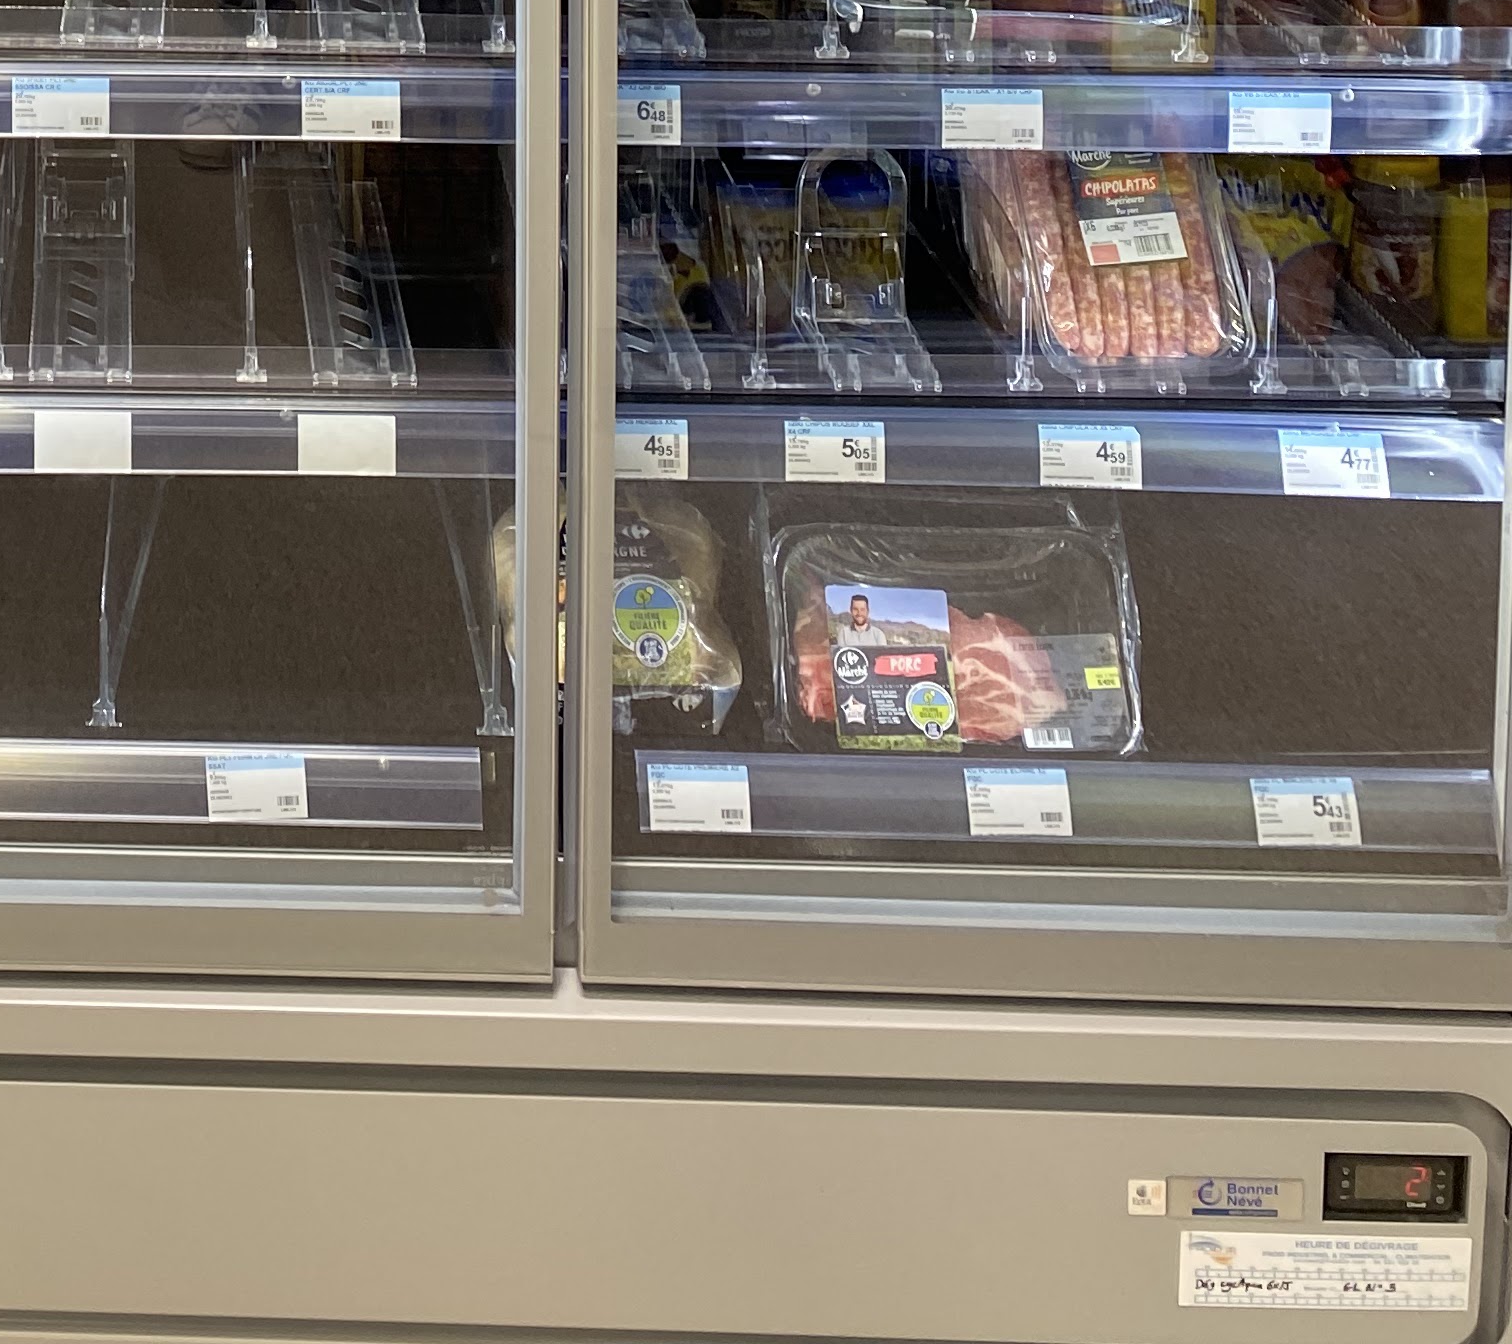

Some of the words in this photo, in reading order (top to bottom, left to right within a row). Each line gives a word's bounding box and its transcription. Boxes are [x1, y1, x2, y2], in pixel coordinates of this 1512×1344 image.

[1083, 175, 1157, 197] CHIPOLATAS
[628, 618, 668, 631] QUALITÉ
[889, 657, 922, 672] PORC
[836, 667, 868, 680] Marché
[1405, 1164, 1428, 1198] 2
[1226, 1182, 1279, 1196] Bonnet
[1226, 1195, 1263, 1207] Névé
[1295, 1240, 1333, 1251] HEURE
[1335, 1241, 1350, 1251] DE
[1353, 1239, 1419, 1251] DÉGIVRAGE
